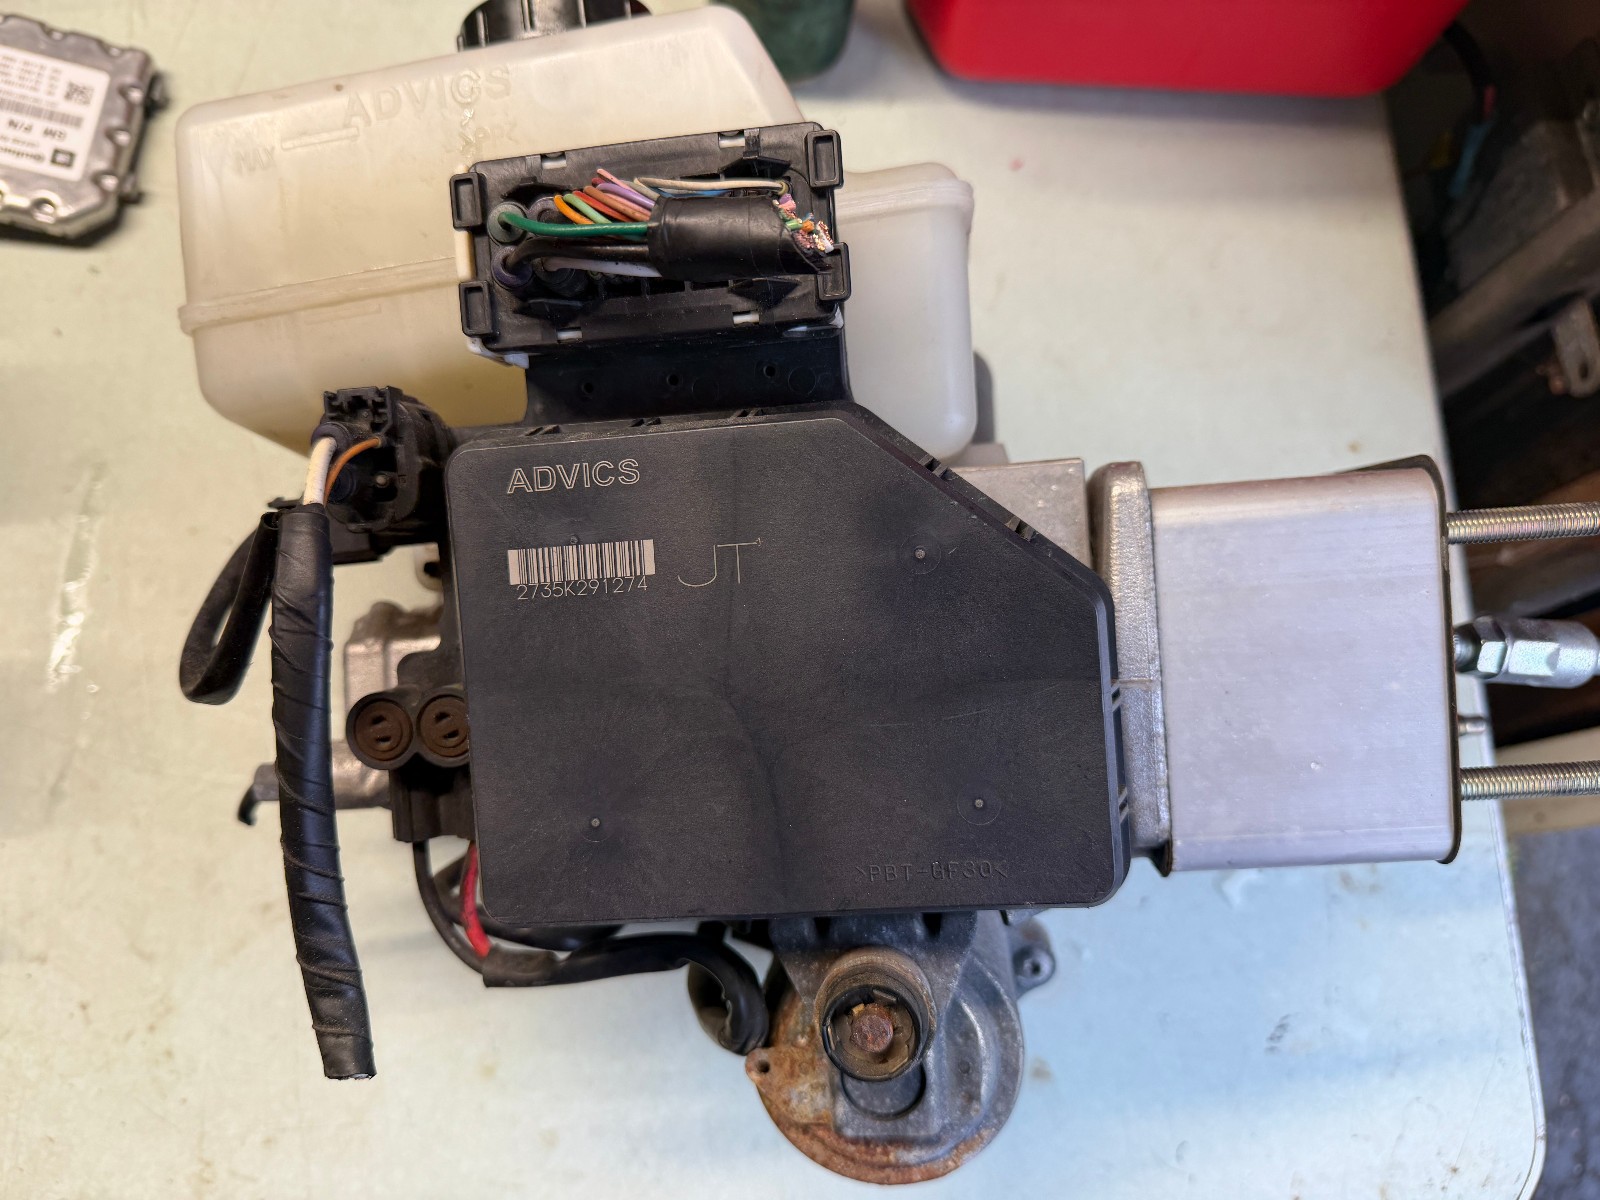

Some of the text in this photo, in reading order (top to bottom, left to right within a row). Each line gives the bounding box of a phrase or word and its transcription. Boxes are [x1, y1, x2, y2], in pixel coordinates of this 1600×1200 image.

[343, 64, 512, 128] ADVICS
[507, 458, 641, 494] ADVICS
[678, 541, 761, 588] JT
[516, 574, 648, 600] 2735K291274
